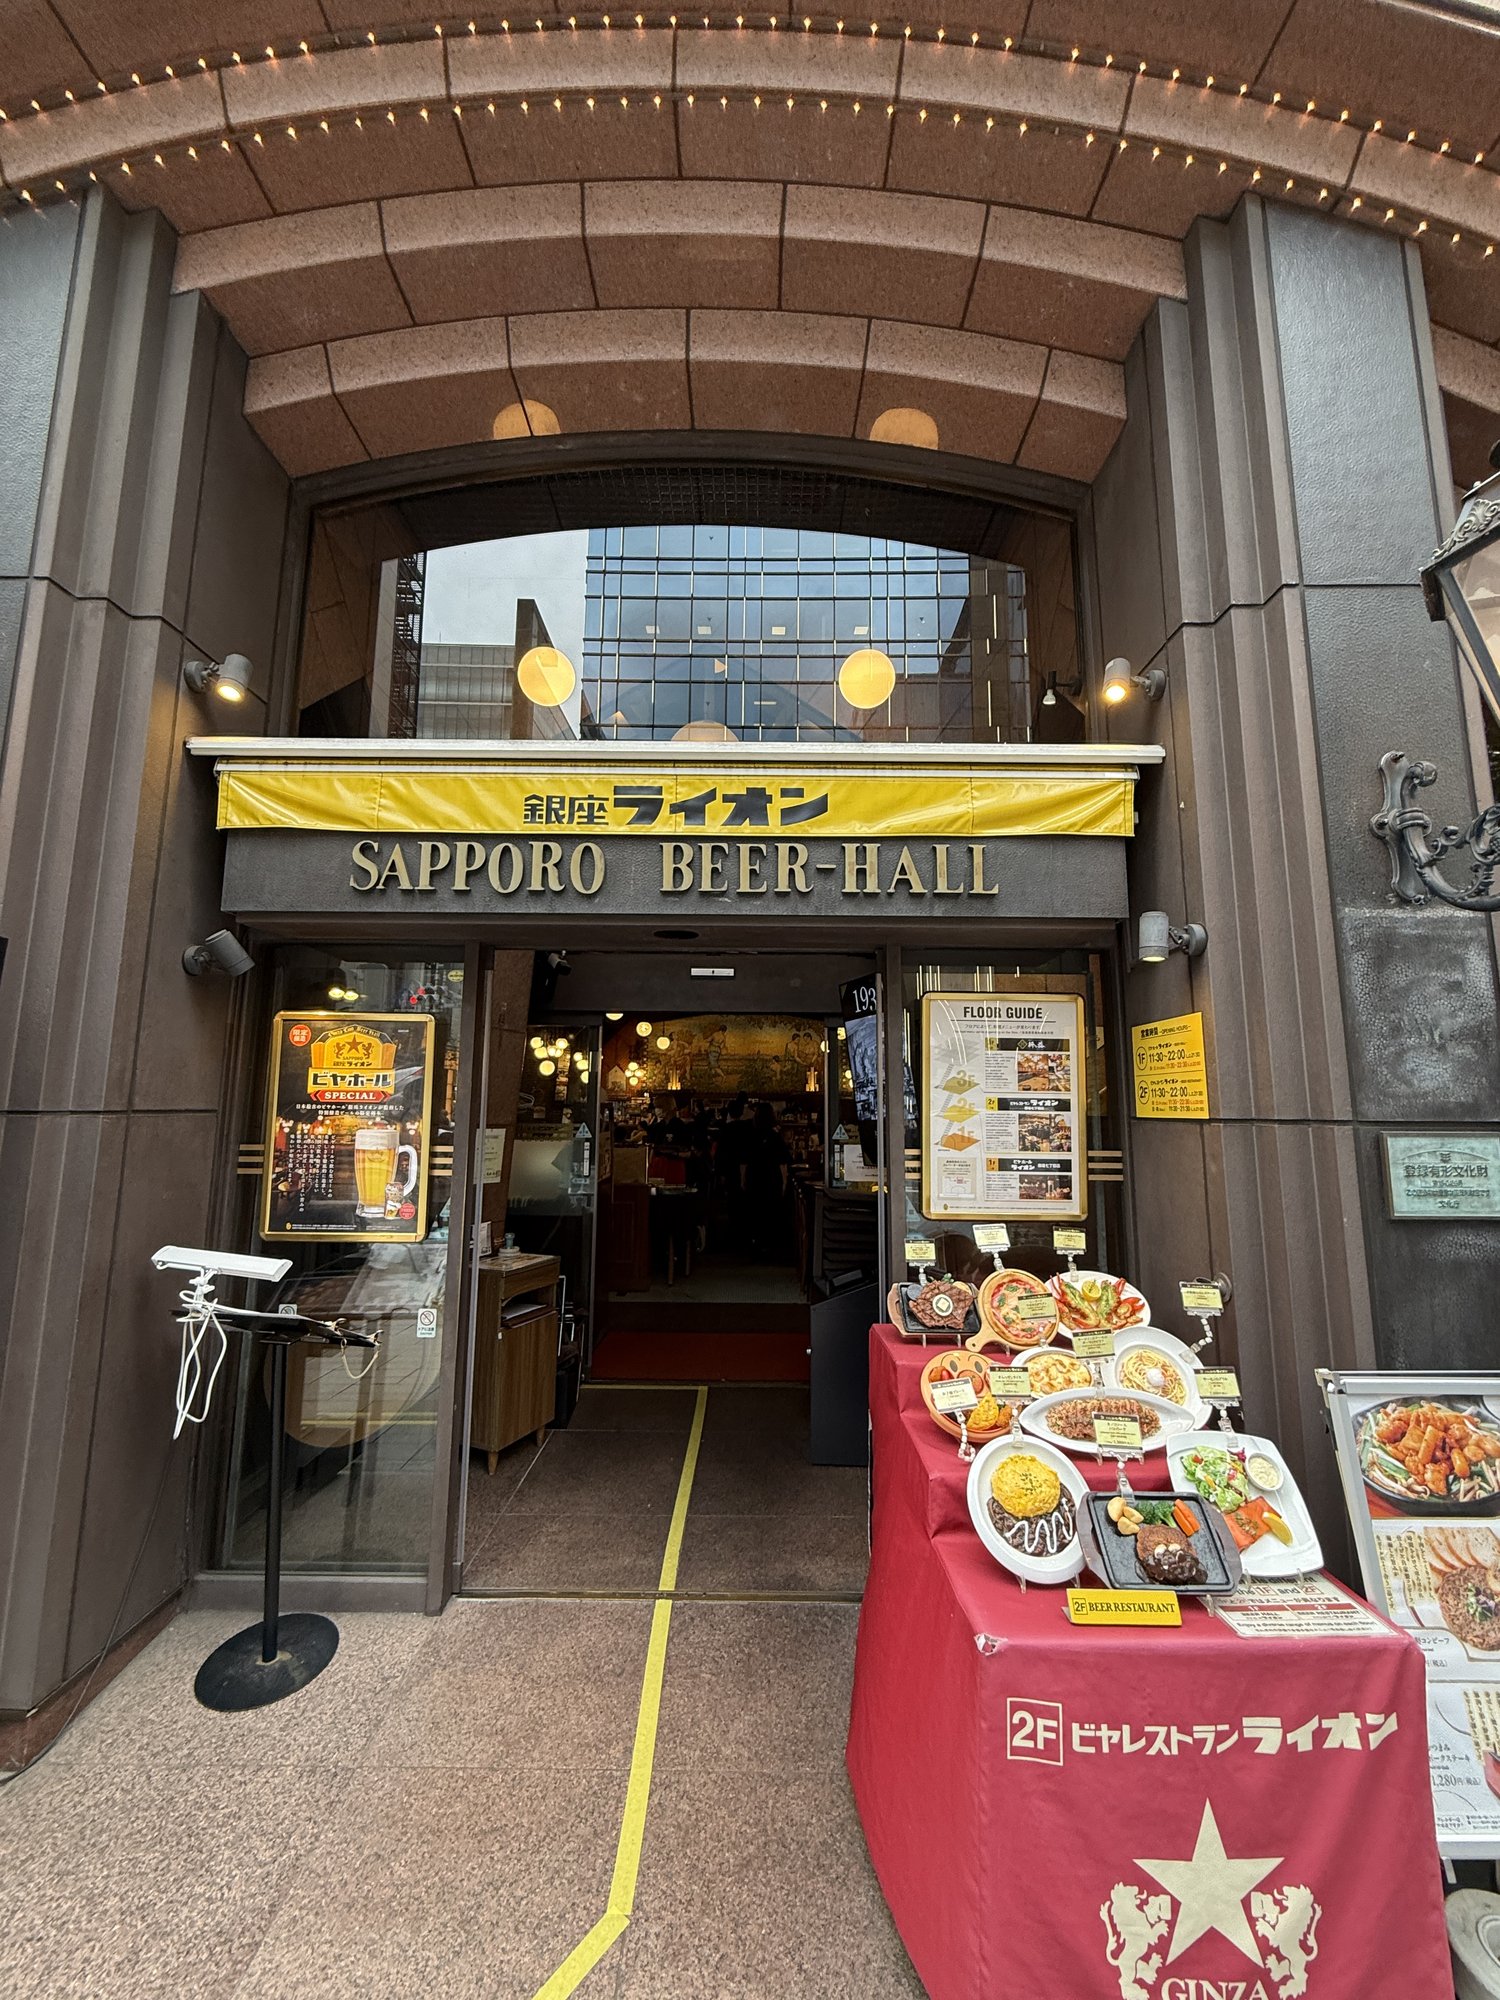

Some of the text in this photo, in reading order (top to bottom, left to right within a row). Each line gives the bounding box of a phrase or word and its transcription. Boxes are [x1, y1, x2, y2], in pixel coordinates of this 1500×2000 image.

[523, 786, 828, 826] 銀座ライオン
[350, 840, 1000, 894] SAPPORO BEER-HALL
[963, 1006, 1043, 1019] FLOOR GUIDE
[1138, 1053, 1145, 1064] 1F
[312, 1073, 391, 1087] ビヤホール
[957, 1070, 975, 1087] 3F
[325, 1092, 376, 1100] SPECIAL
[1140, 1086, 1147, 1098] 2F
[1403, 1165, 1488, 1177] 登録有形文化財
[1257, 1586, 1271, 1594] 1F
[1278, 1587, 1300, 1595] and
[1075, 1602, 1175, 1612] 2F BEER RESTAURANT
[1012, 1711, 1398, 1755] 2F ビヤレストランライオン
